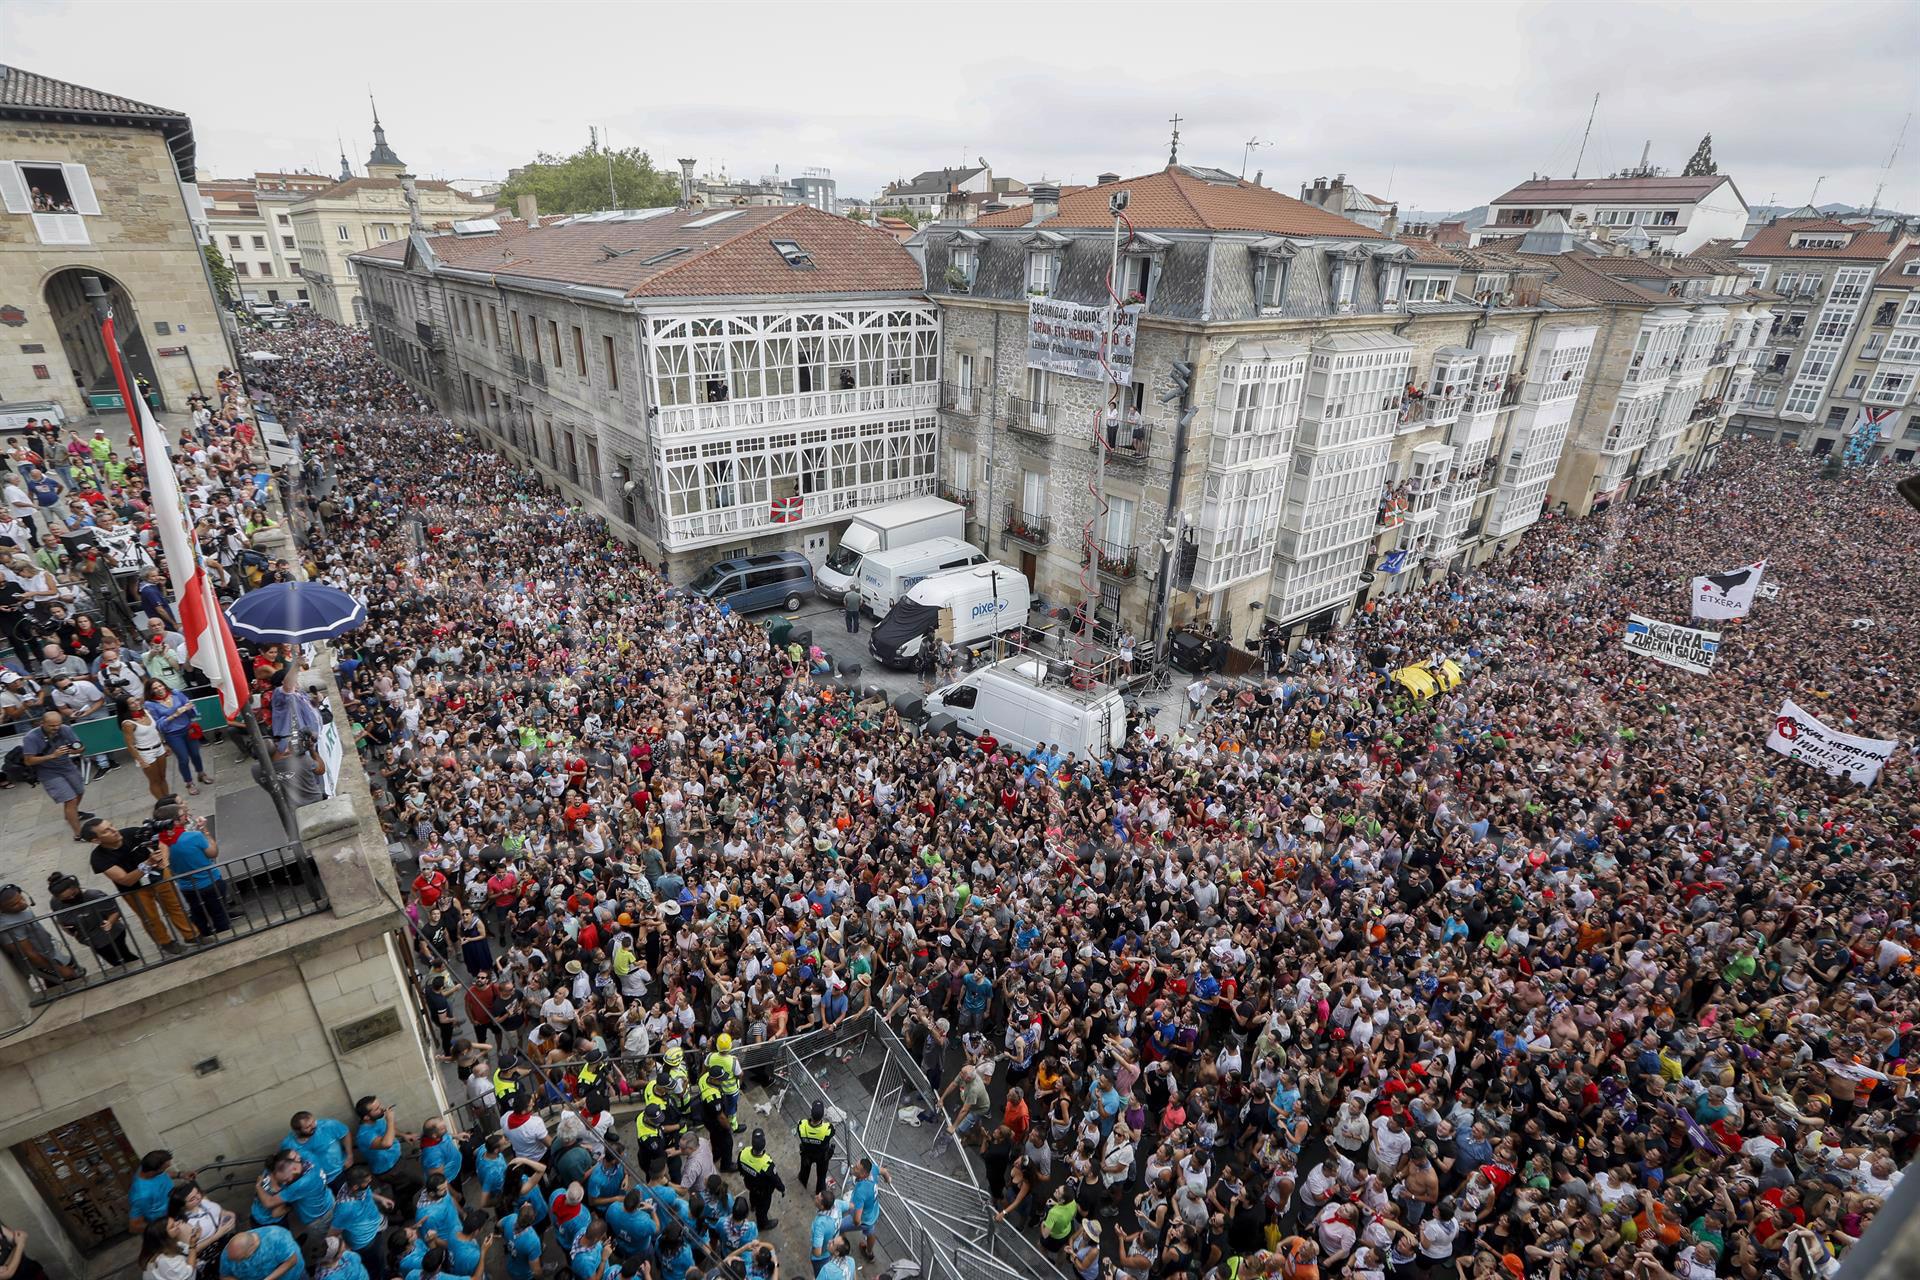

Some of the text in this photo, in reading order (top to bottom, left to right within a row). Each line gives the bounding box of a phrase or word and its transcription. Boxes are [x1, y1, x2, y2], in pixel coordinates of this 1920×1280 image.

[1032, 302, 1068, 320] SEGURIDAD
[1072, 309, 1101, 324] SOCIAL
[1054, 324, 1066, 339] ETA
[1069, 327, 1094, 342] HEMEN
[1100, 330, 1119, 345] 100
[972, 601, 997, 619] pixe
[1700, 594, 1742, 609] ETXERA
[1631, 632, 1674, 656] ZUREKIN
[1674, 643, 1713, 666] GAUDE
[1828, 740, 1888, 763] HERRIAK
